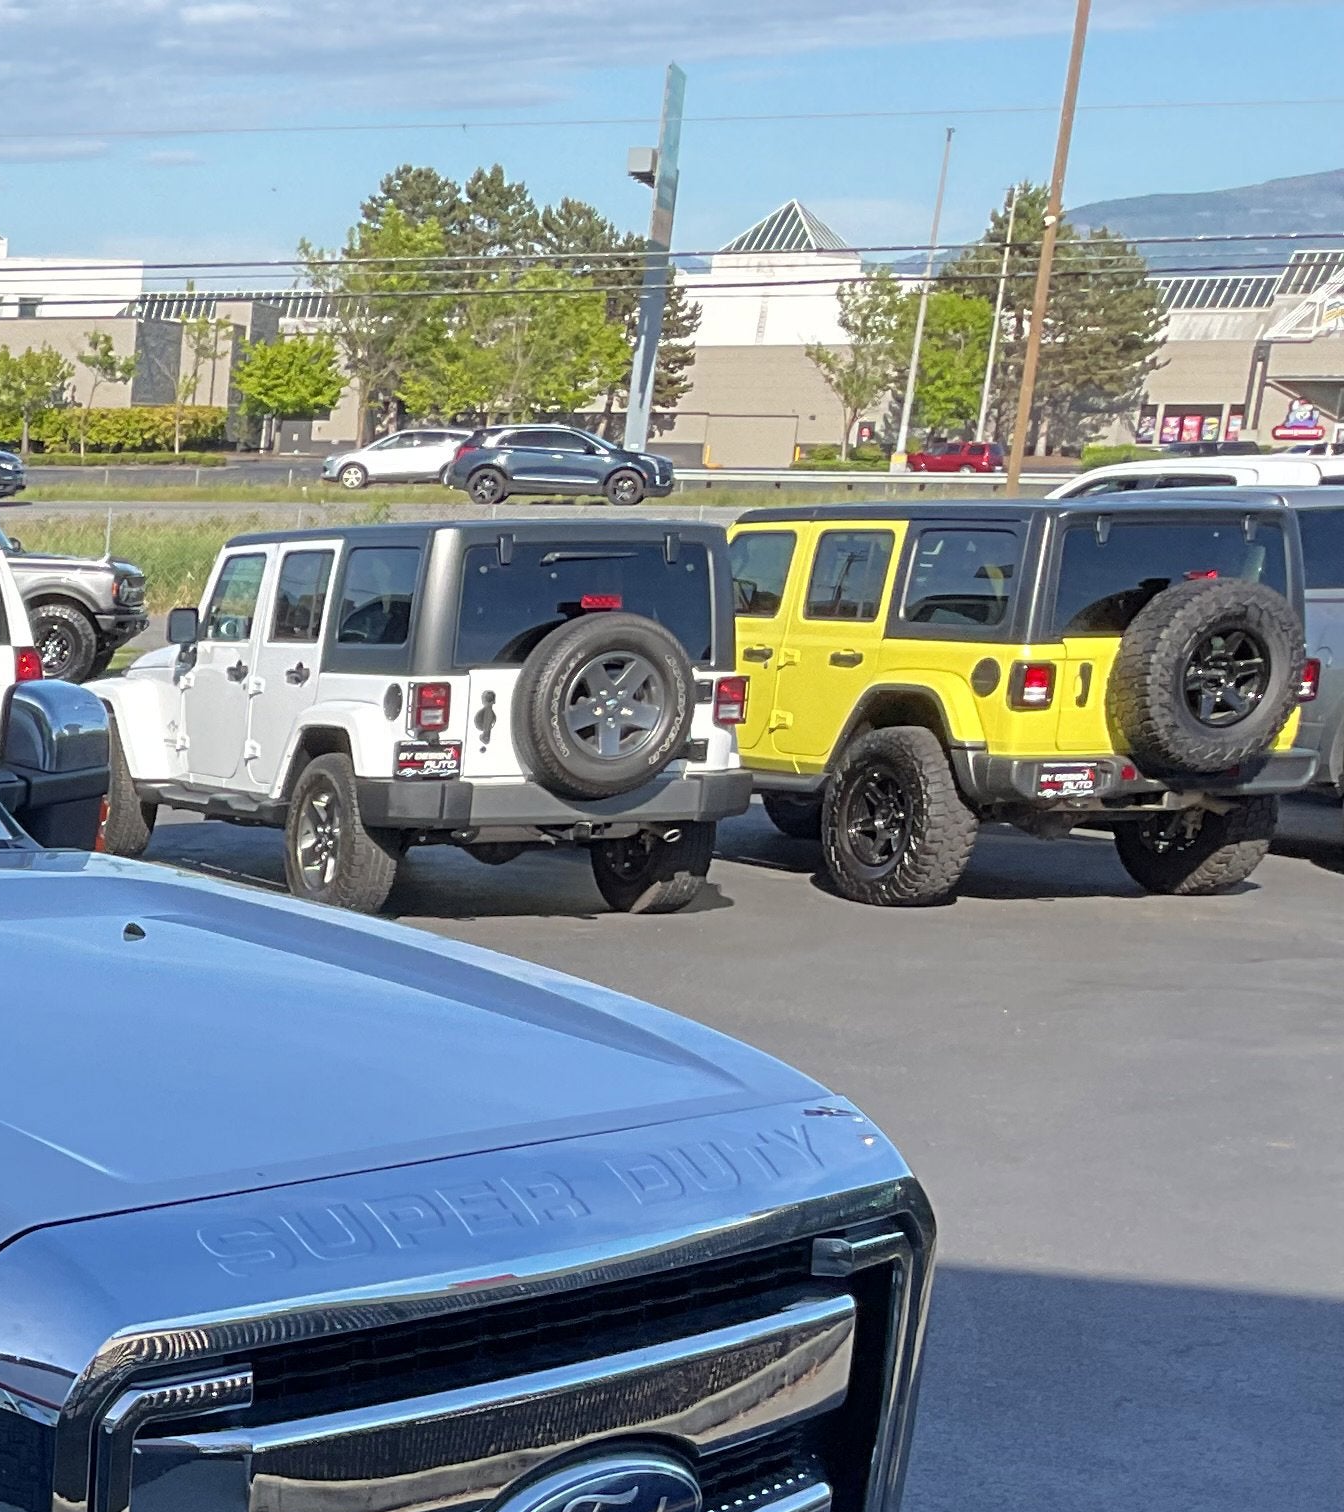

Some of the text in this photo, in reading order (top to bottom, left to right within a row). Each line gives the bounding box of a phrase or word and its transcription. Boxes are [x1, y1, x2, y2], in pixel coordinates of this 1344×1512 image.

[398, 752, 413, 760] BY
[423, 760, 457, 769] AUTO
[196, 1122, 827, 1279] SUPER DUTY
